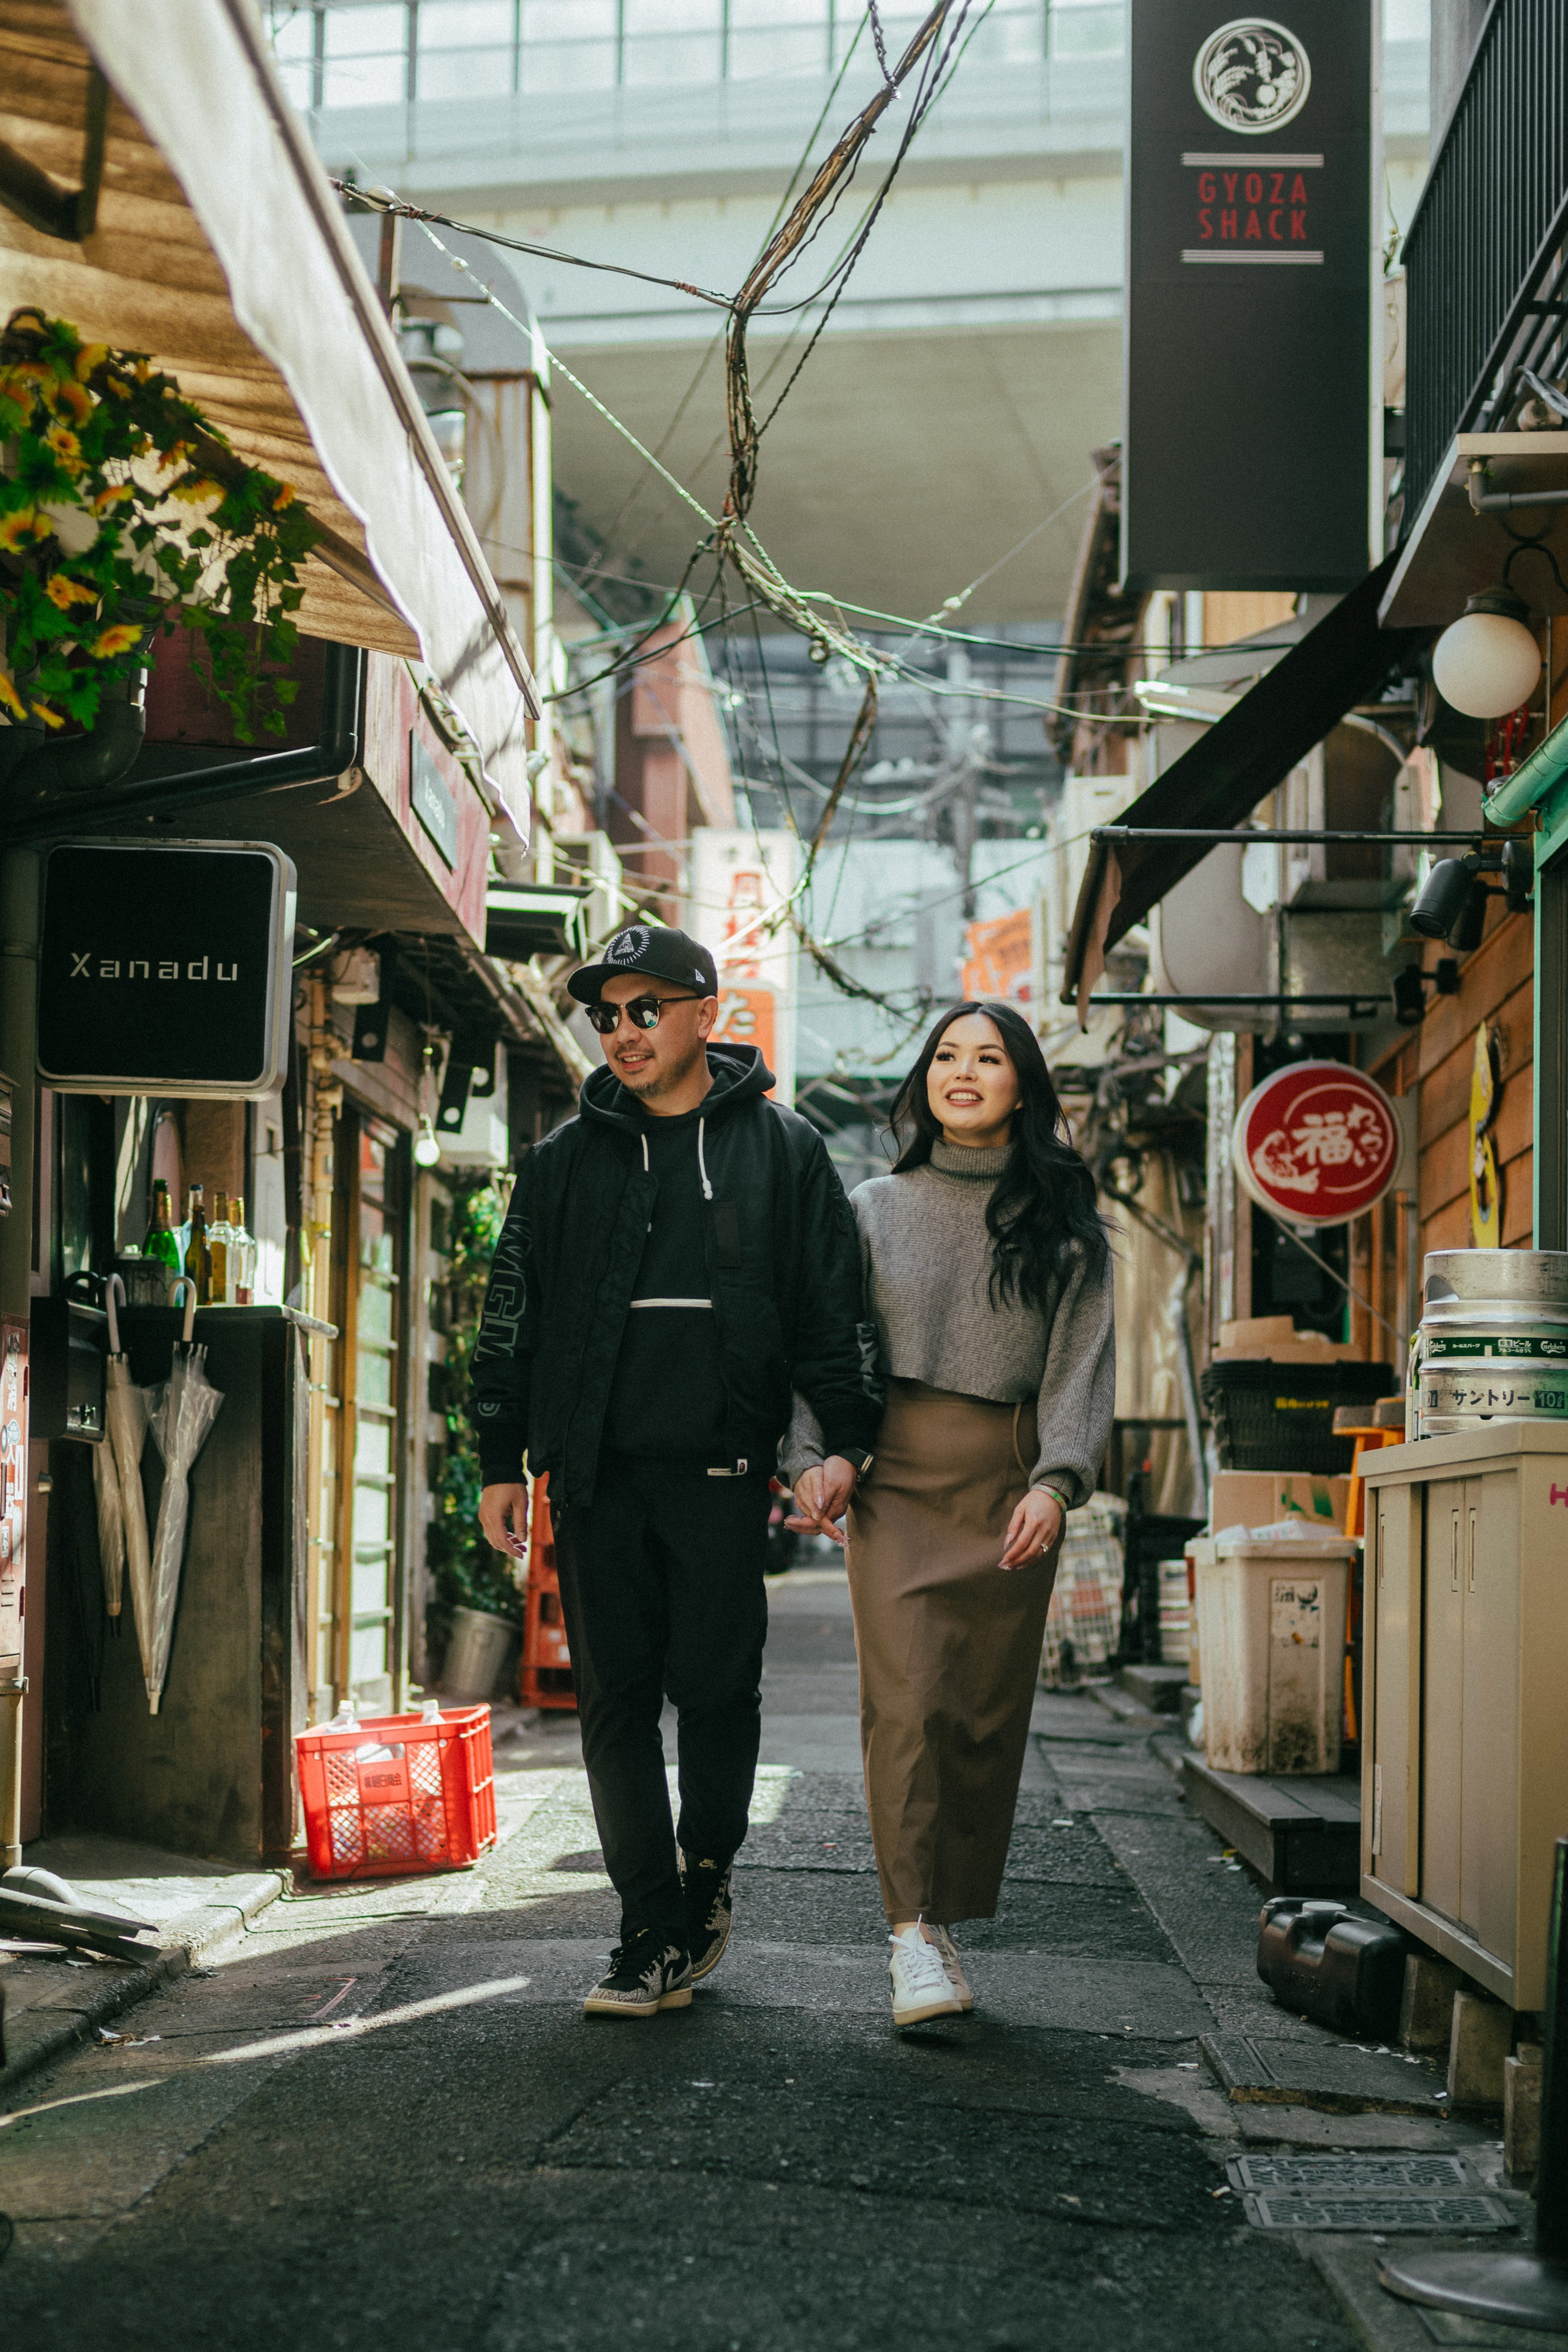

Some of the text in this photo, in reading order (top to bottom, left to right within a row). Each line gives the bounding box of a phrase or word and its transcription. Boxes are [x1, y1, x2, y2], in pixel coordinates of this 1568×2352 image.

[1198, 172, 1308, 204] GYOZA
[1198, 208, 1308, 241] SHACK
[70, 952, 238, 981] Xanadu
[1291, 1111, 1354, 1166] 福
[1540, 1340, 1566, 1354] Carlsberg
[1452, 1389, 1531, 1407] サントリー
